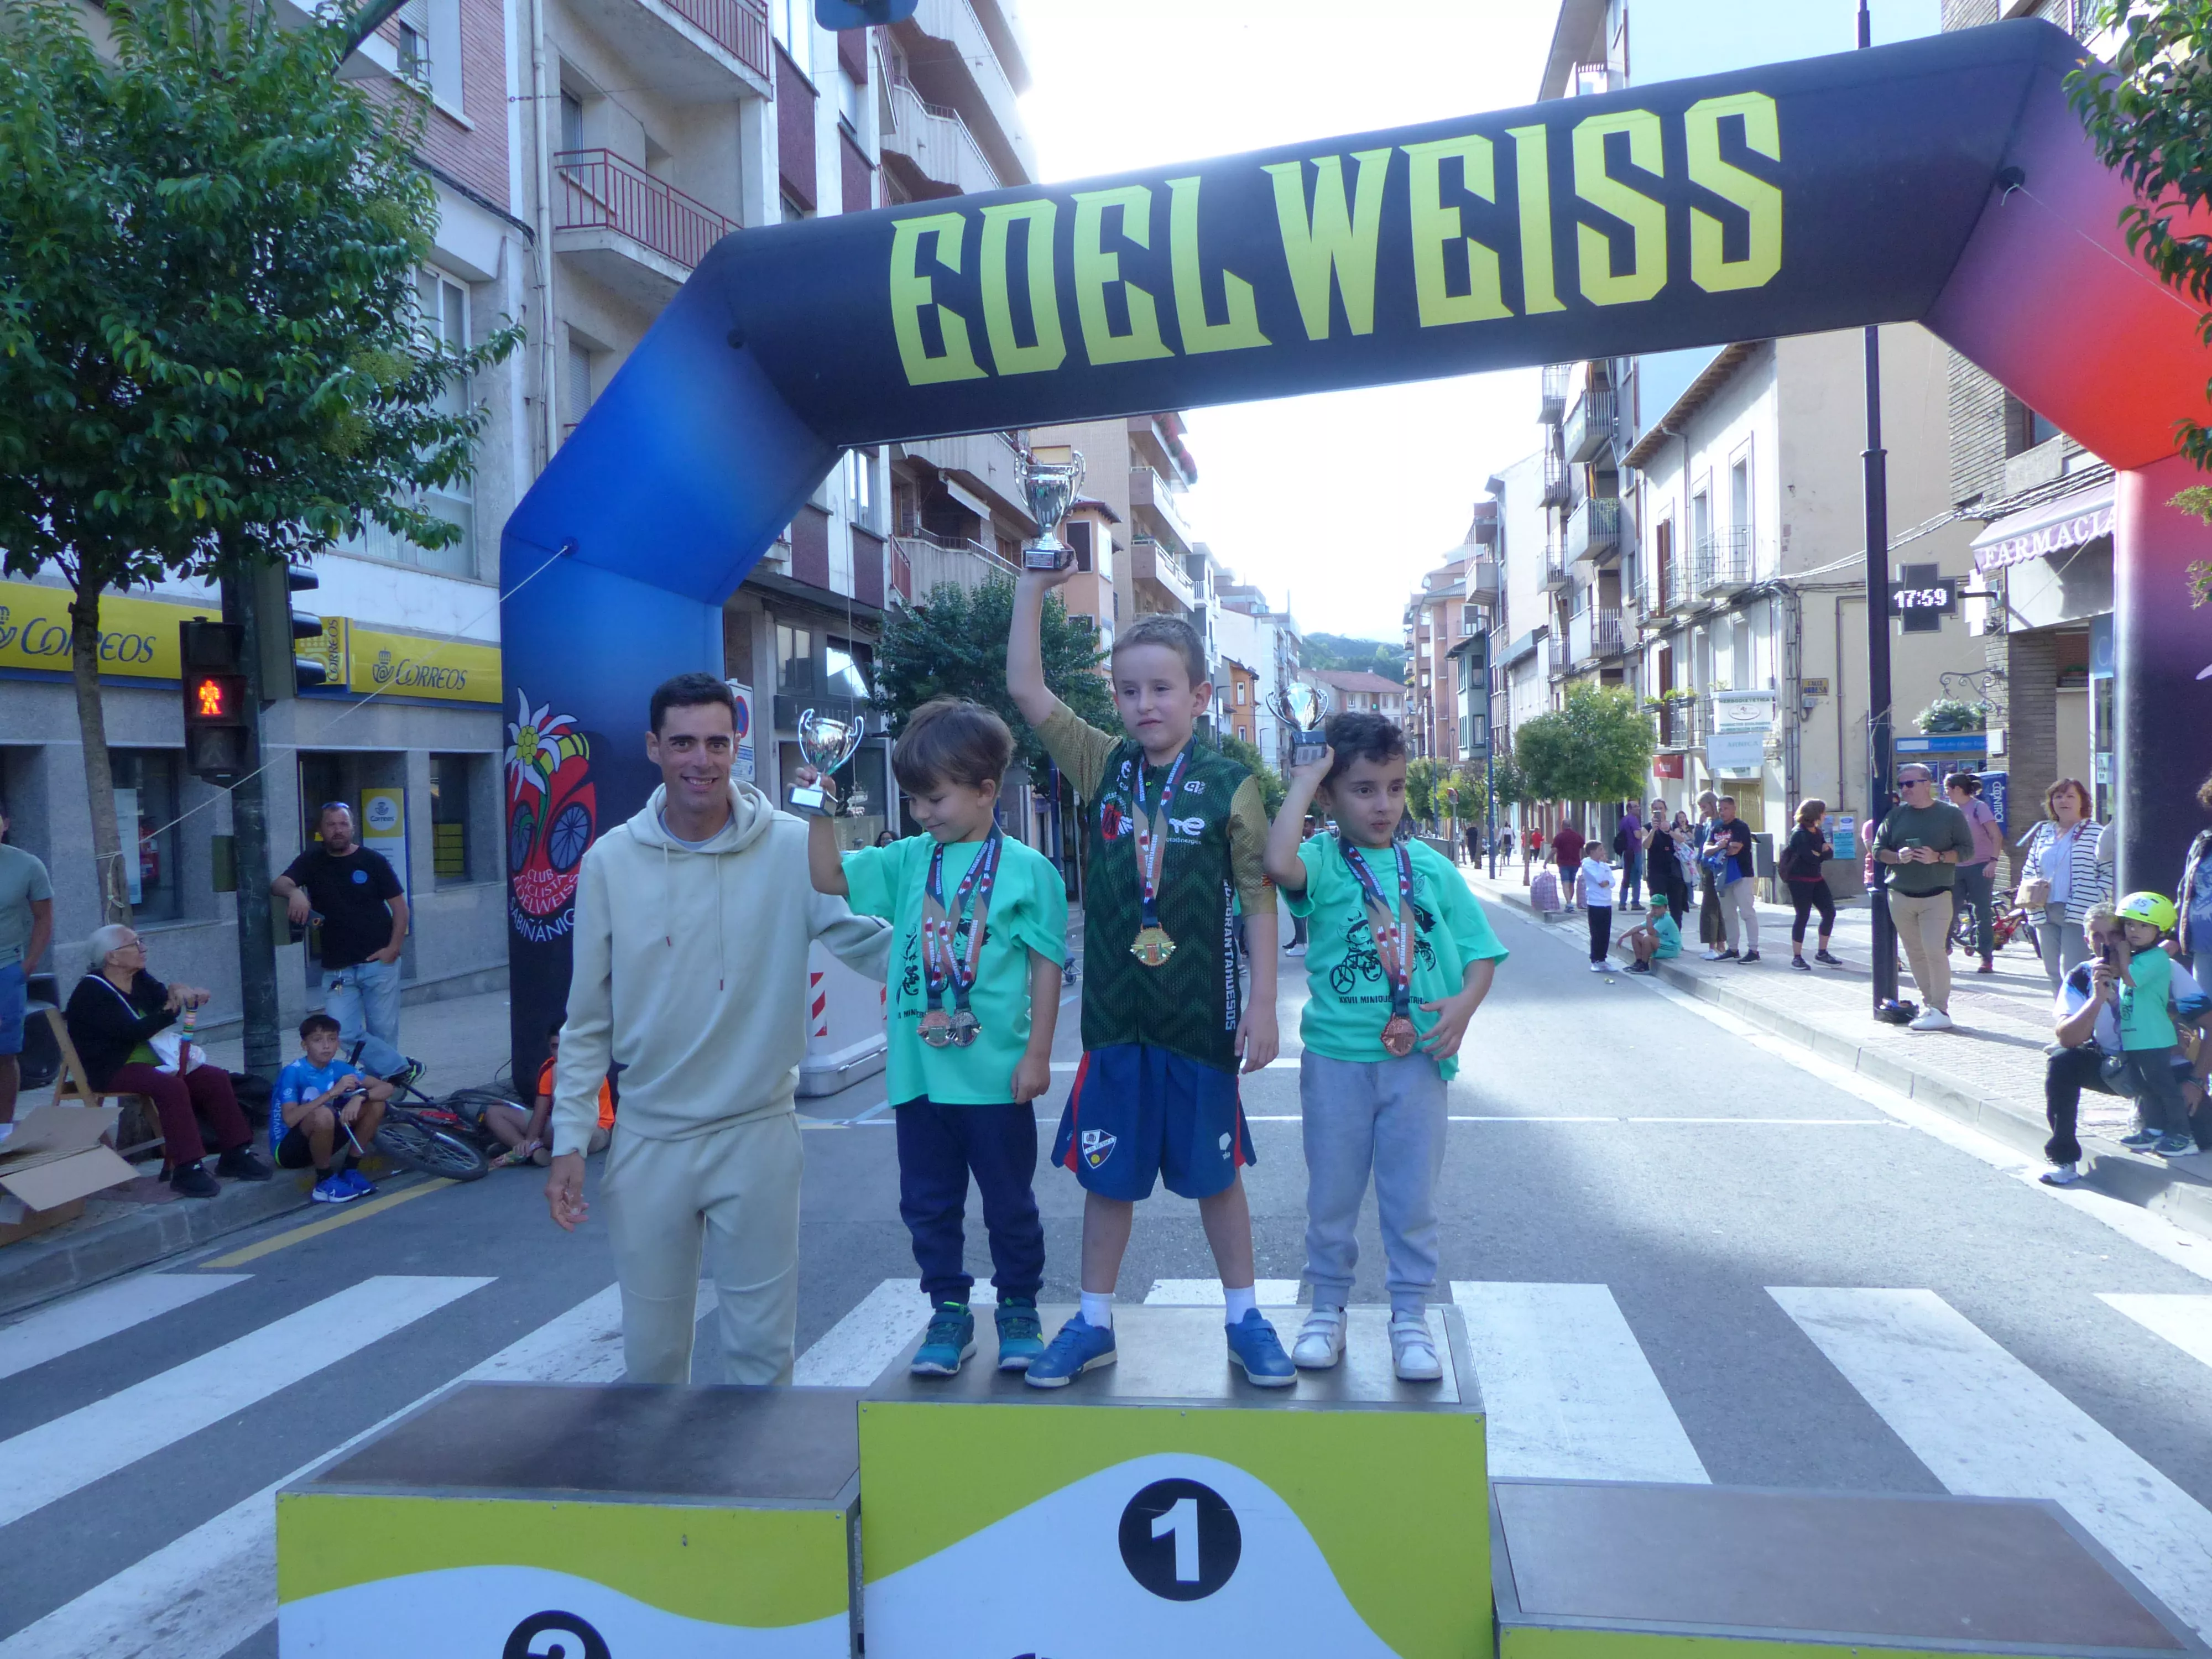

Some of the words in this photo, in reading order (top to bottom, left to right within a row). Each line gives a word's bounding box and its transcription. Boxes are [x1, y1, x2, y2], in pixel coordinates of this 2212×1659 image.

[889, 90, 1783, 386] EDELWEISS
[1893, 588, 1947, 608] 17:59
[20, 617, 156, 663] COEOS
[396, 659, 468, 690] CORREOS
[520, 874, 567, 898] CICLISTA
[527, 869, 554, 883] CLUB
[510, 896, 575, 942] SABIÑÁNIG
[1339, 996, 1358, 1004] XXVII
[1151, 1498, 1200, 1582] 1
